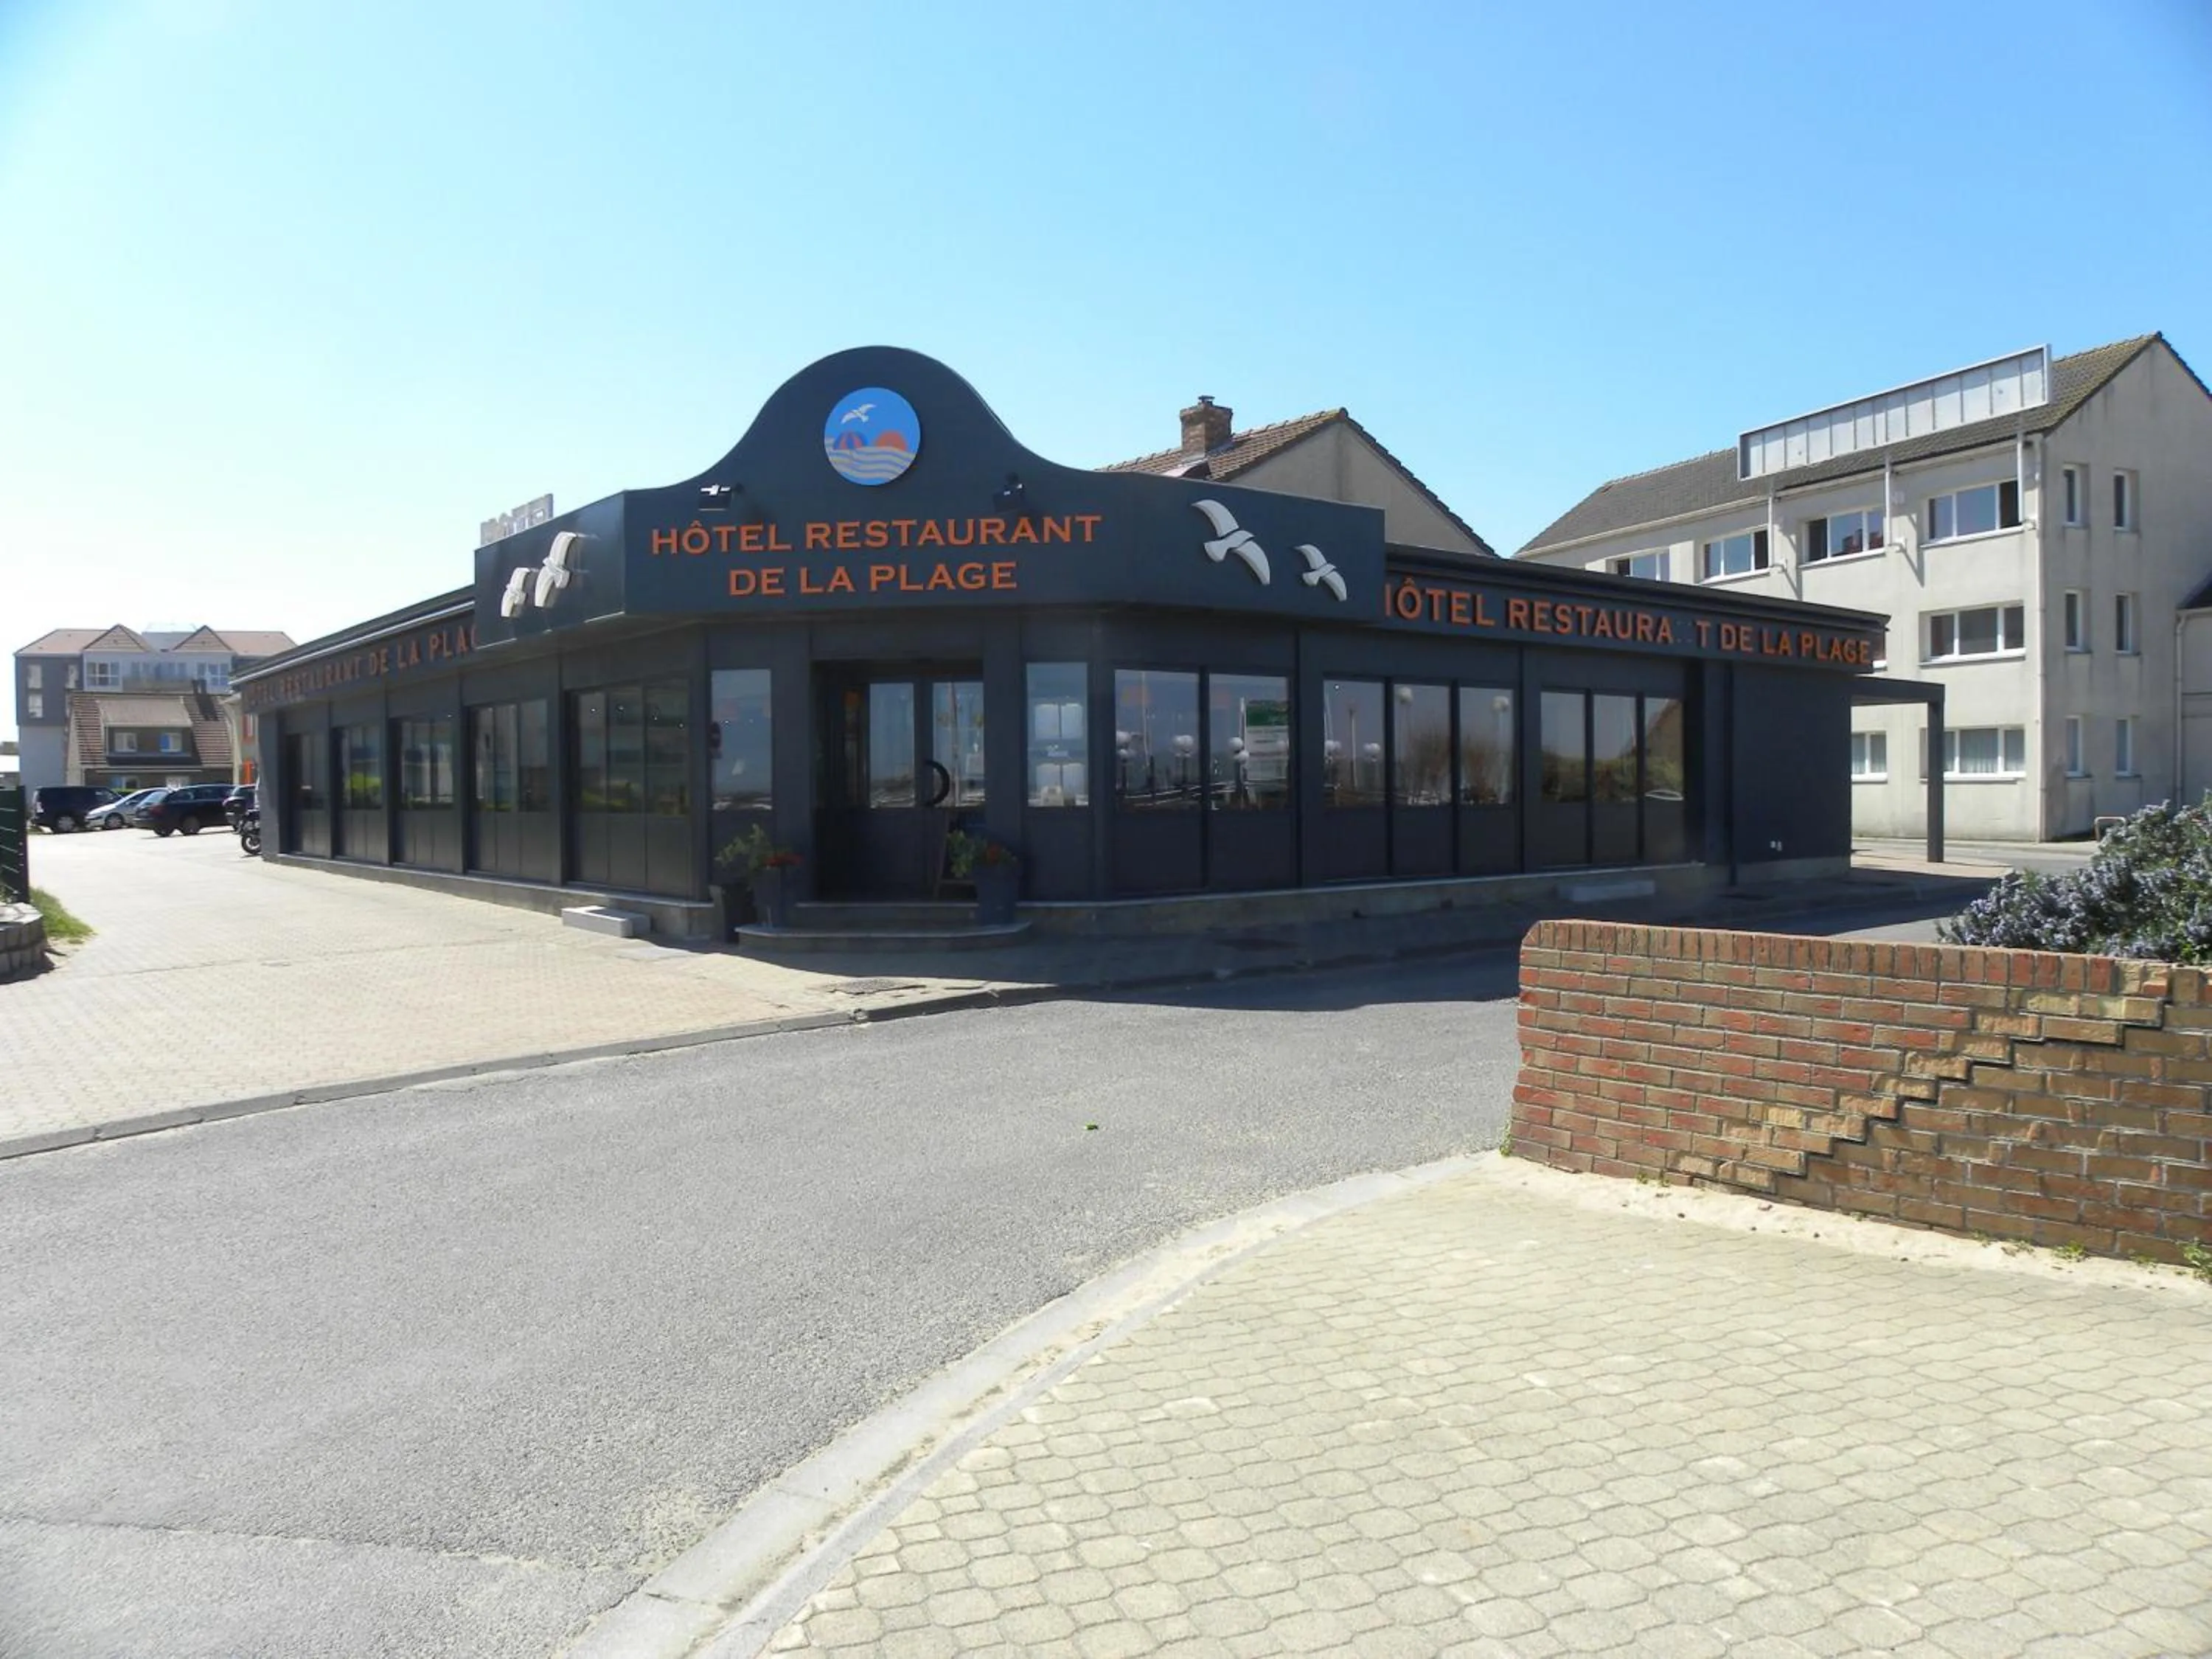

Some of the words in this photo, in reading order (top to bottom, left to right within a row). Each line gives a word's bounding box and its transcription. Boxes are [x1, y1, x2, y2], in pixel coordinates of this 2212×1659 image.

[652, 520, 793, 554] HÔTEL
[805, 515, 1102, 550] RESTAURANT
[729, 566, 785, 596] DE
[800, 566, 855, 594] LA
[869, 561, 1017, 592] PLAGE
[369, 647, 389, 676] DE
[397, 639, 421, 669] LA
[1719, 622, 1753, 652] DE
[1761, 629, 1792, 656] LA
[1800, 632, 1871, 664] PLAGE
